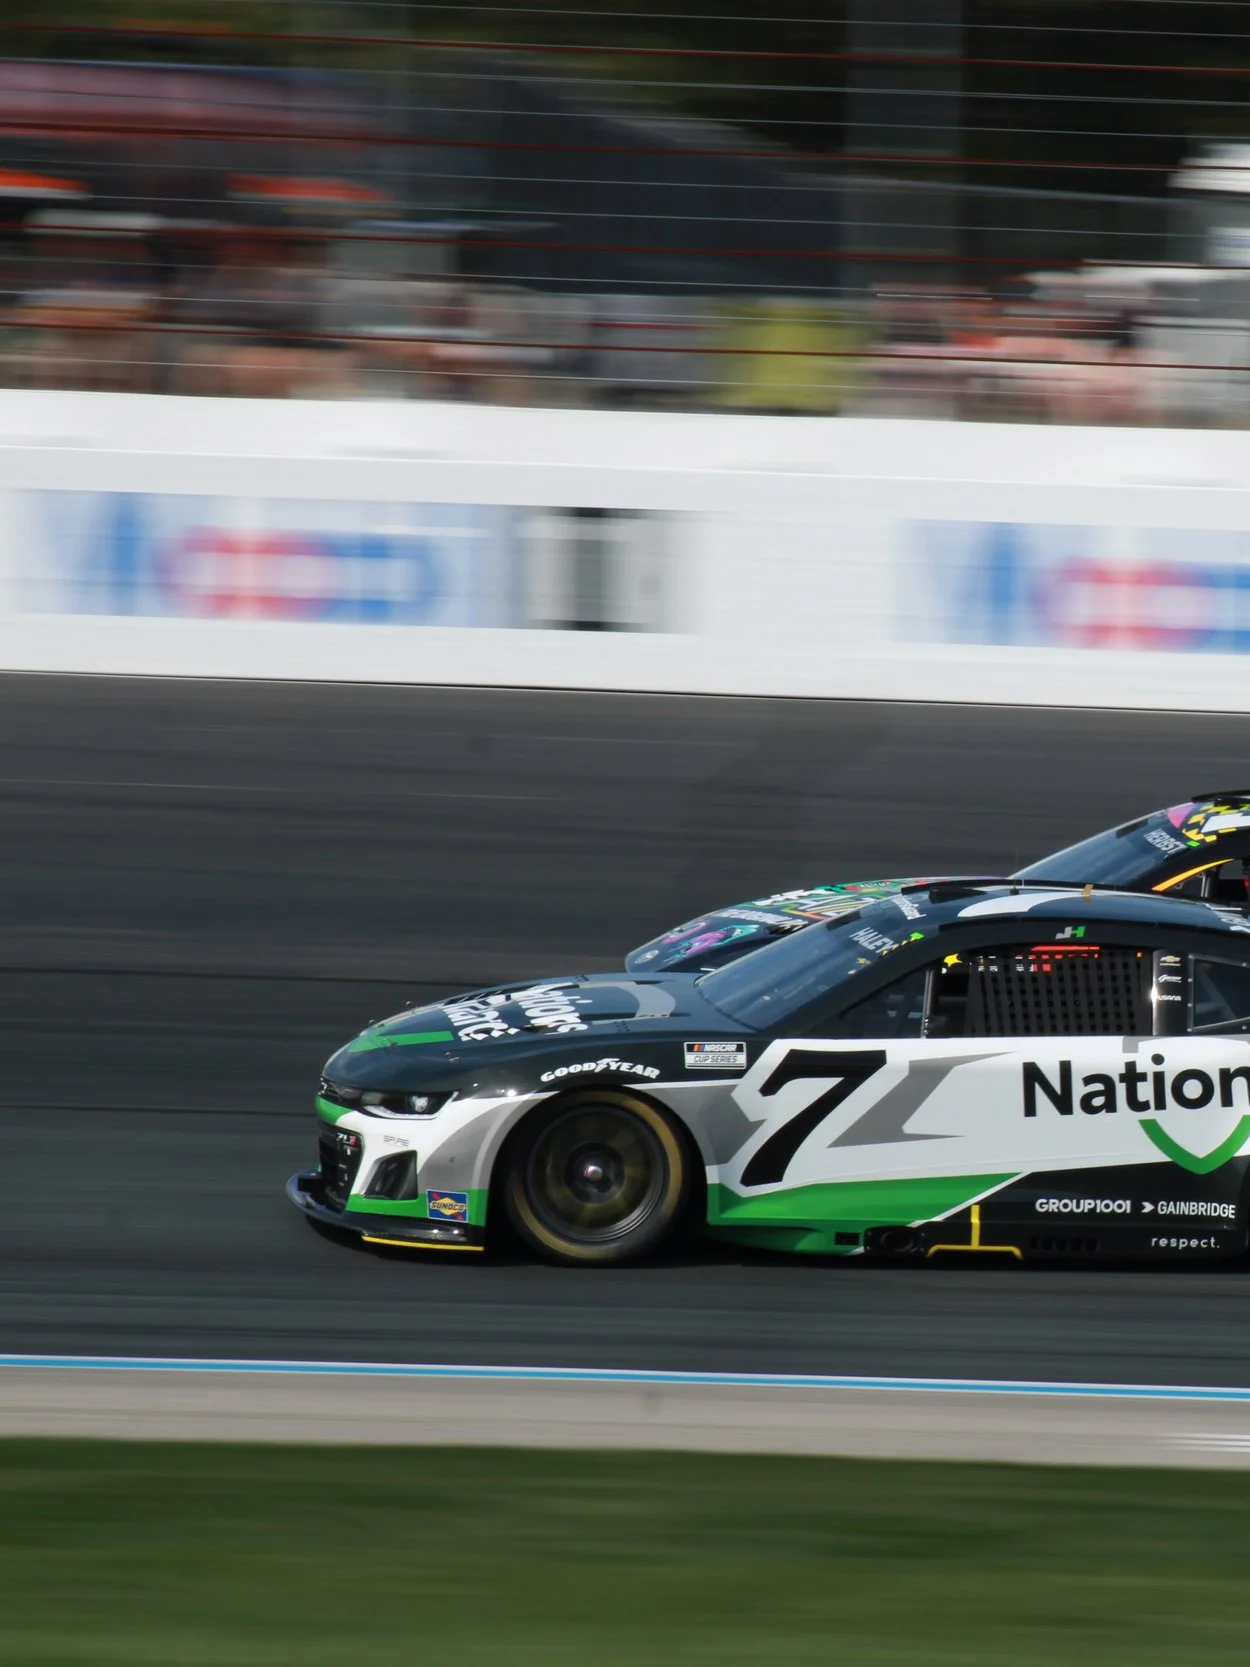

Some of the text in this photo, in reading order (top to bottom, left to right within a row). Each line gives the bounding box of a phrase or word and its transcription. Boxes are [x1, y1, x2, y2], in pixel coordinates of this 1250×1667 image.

[1143, 828, 1187, 855] HERBST
[848, 926, 900, 954] HALEY
[703, 1044, 737, 1052] NASCAR
[540, 1058, 660, 1082] GOODYEAR
[740, 1048, 887, 1187] 7
[430, 1201, 465, 1212] SUNOCO
[1035, 1199, 1236, 1219] GROUP1001 GAINBRIDGE
[1151, 1237, 1220, 1249] respect.
